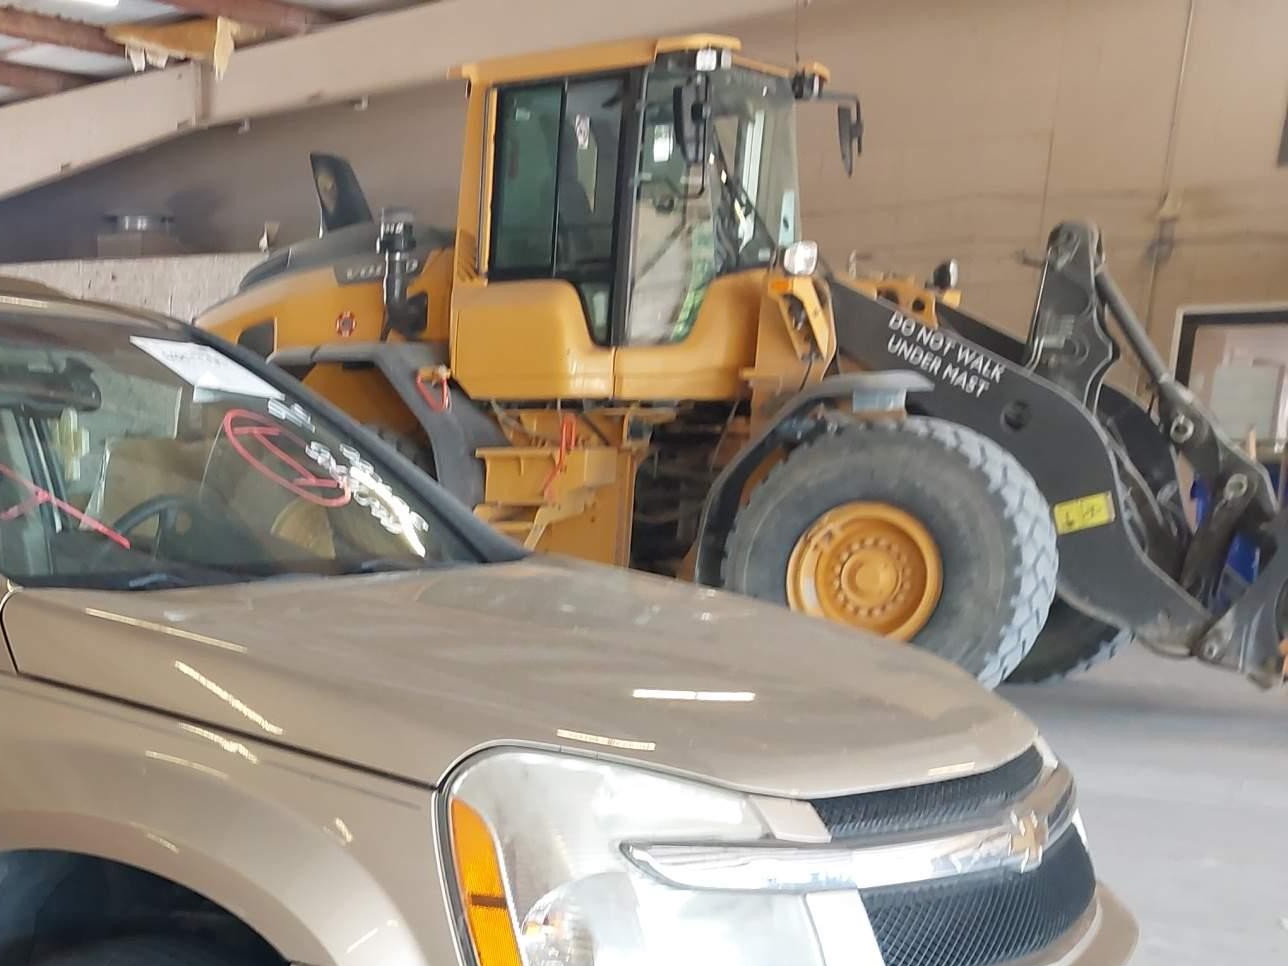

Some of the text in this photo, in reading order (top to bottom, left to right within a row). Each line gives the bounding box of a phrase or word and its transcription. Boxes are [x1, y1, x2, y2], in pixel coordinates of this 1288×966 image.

[345, 259, 418, 281] VOLO
[887, 334, 991, 398] UNDER MAST
[888, 310, 1006, 384] DO NOT WALK
